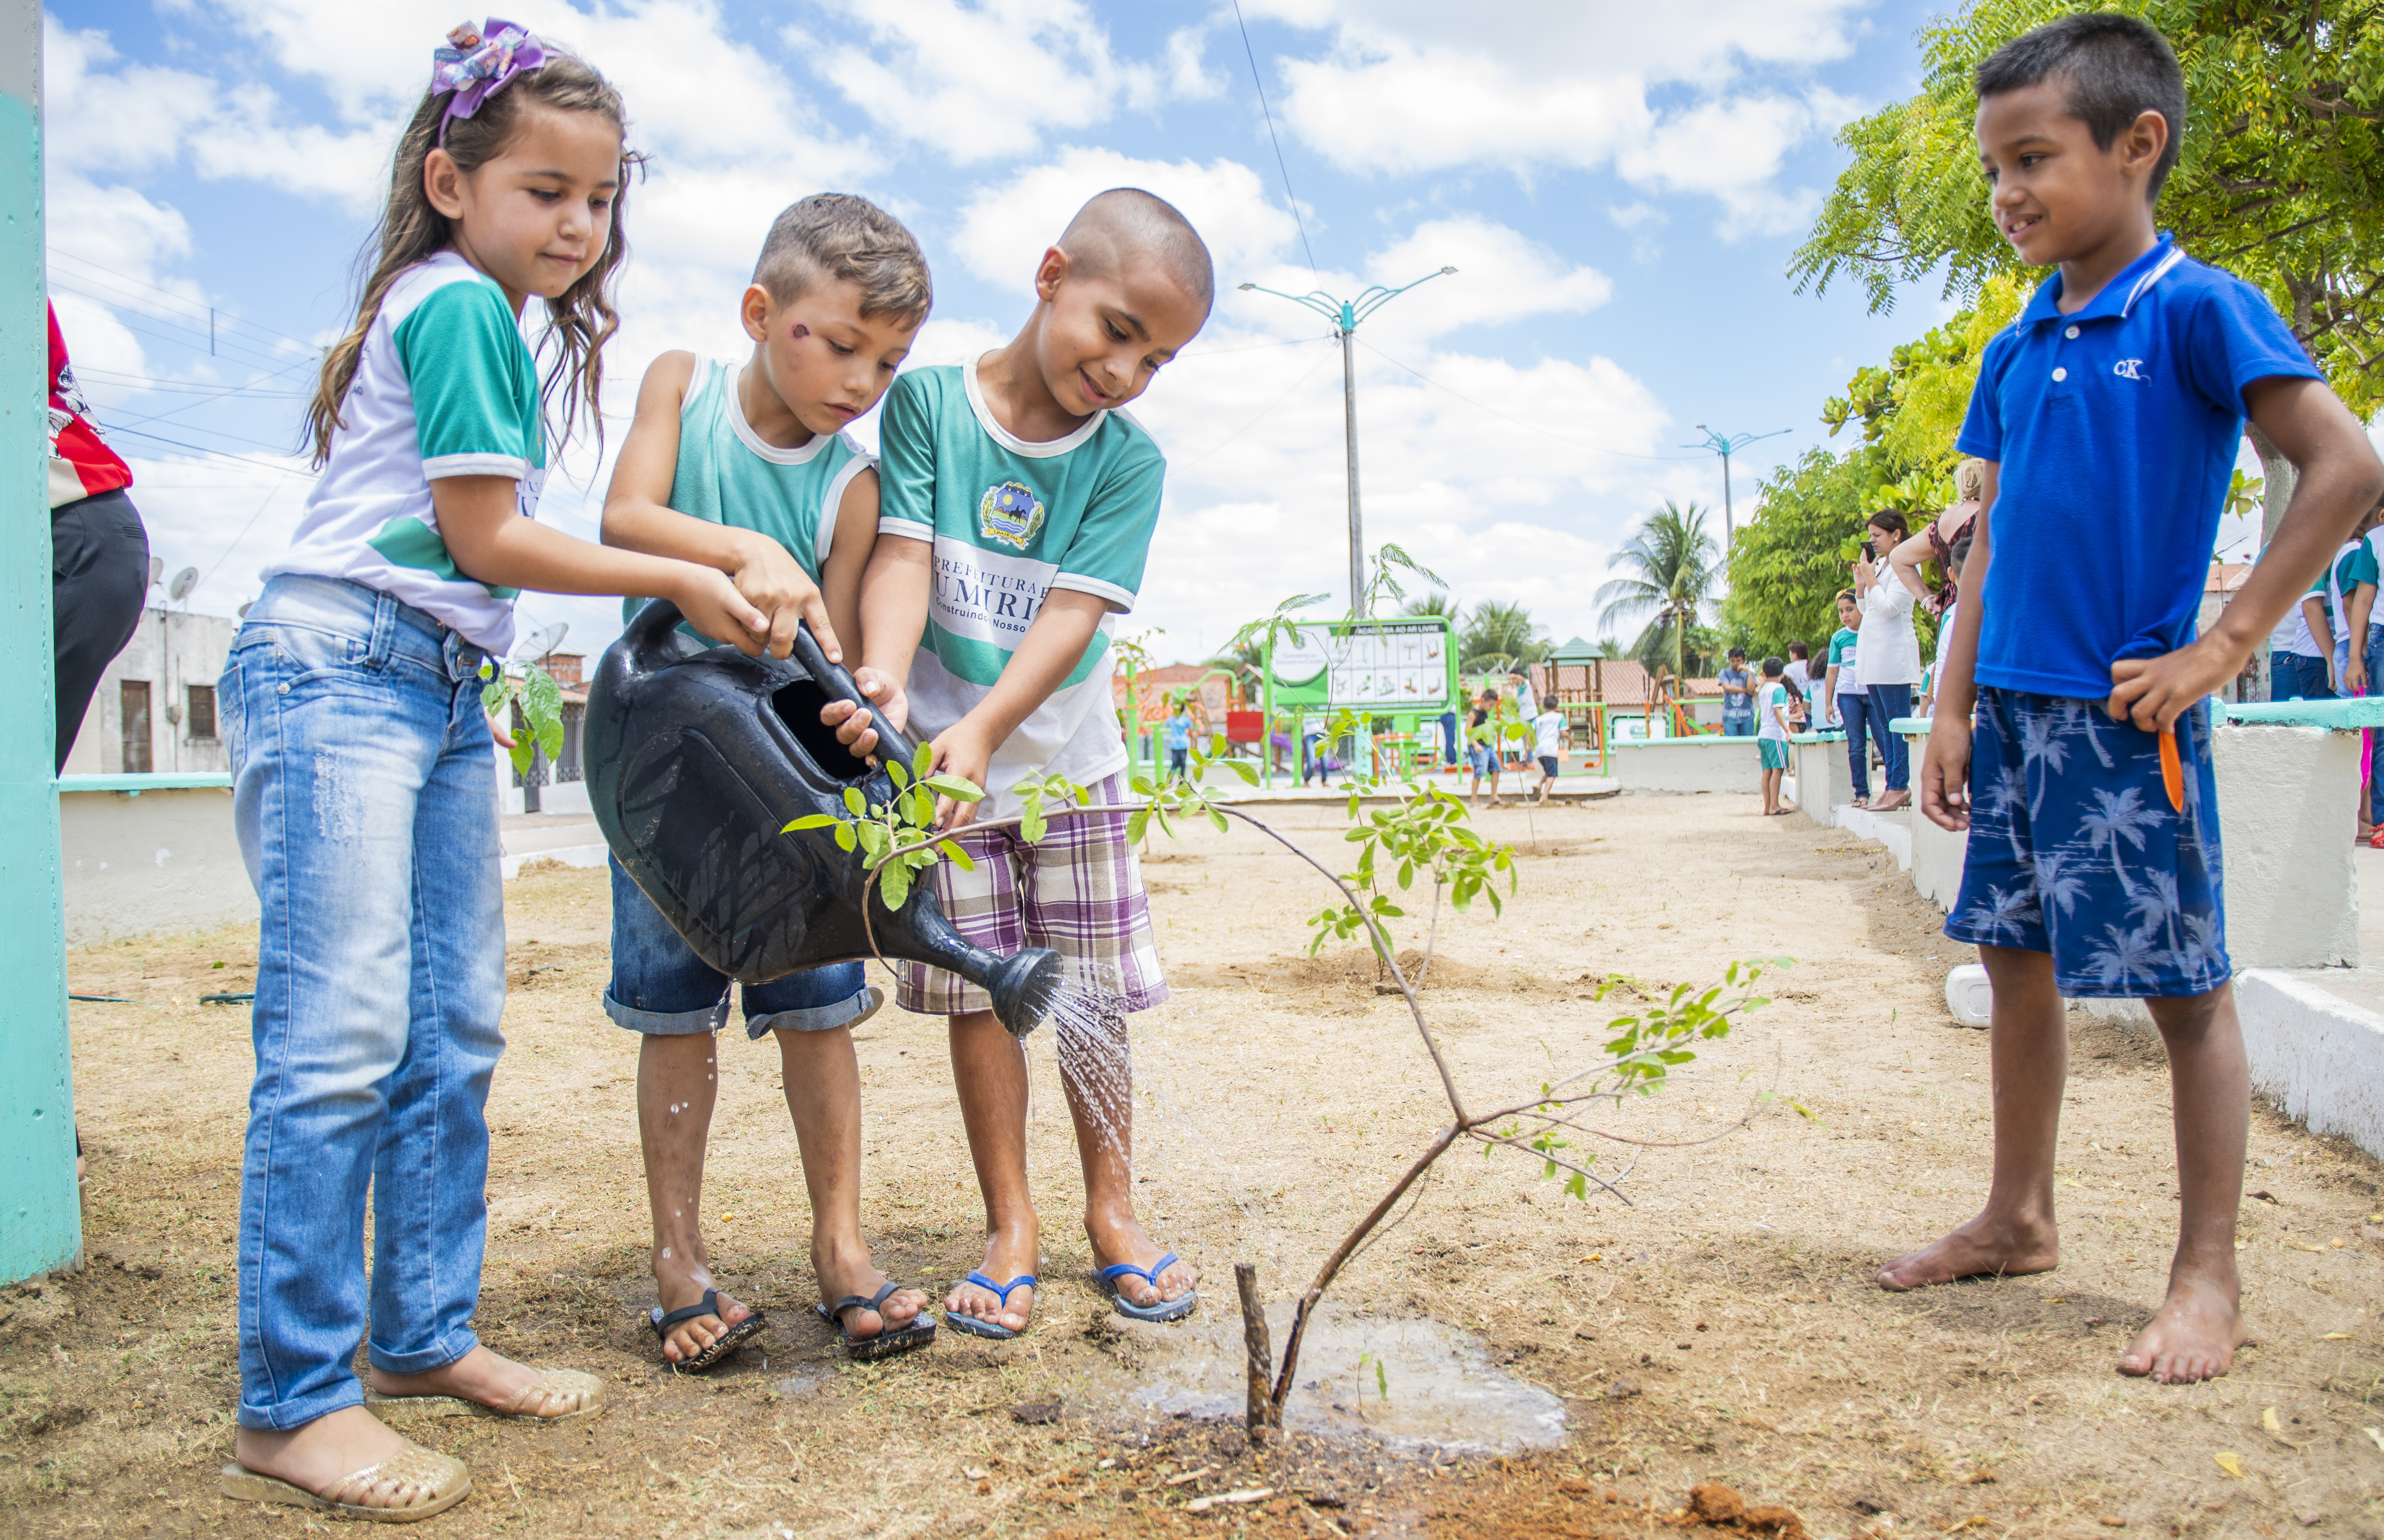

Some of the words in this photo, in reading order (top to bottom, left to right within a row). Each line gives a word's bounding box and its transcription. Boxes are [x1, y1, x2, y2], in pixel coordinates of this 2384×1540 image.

[2114, 359, 2143, 380] CK
[994, 530, 1018, 541] UMIRIM
[934, 555, 1036, 594] PREFEITURA
[934, 570, 1043, 621] UMIRI
[936, 597, 987, 622] Construindo
[993, 618, 1026, 632] Nosso
[1395, 625, 1406, 633] AO
[1406, 625, 1417, 633] AR
[1418, 624, 1439, 633] LIVRE
